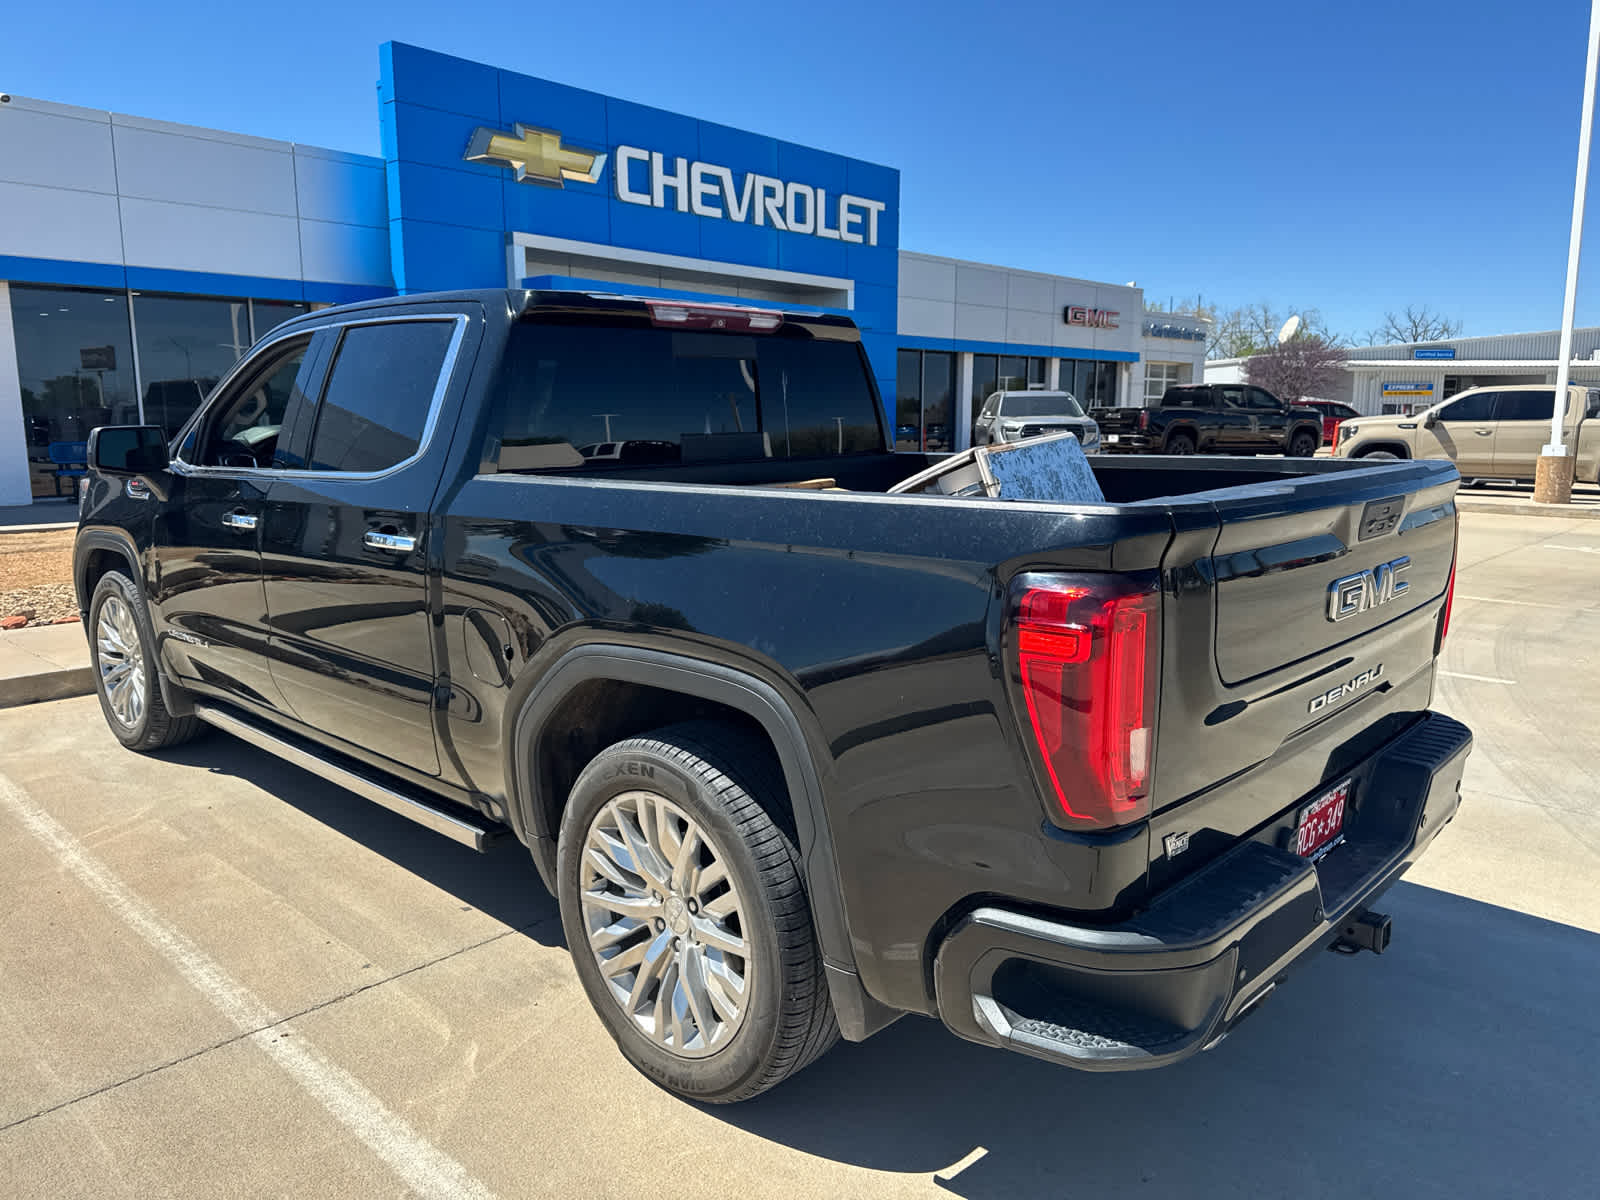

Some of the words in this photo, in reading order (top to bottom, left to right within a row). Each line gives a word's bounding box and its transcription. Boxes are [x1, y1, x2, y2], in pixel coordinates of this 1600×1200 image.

[616, 145, 885, 246] CHEVROLET
[1064, 306, 1120, 328] GMC
[1327, 555, 1413, 622] GMC
